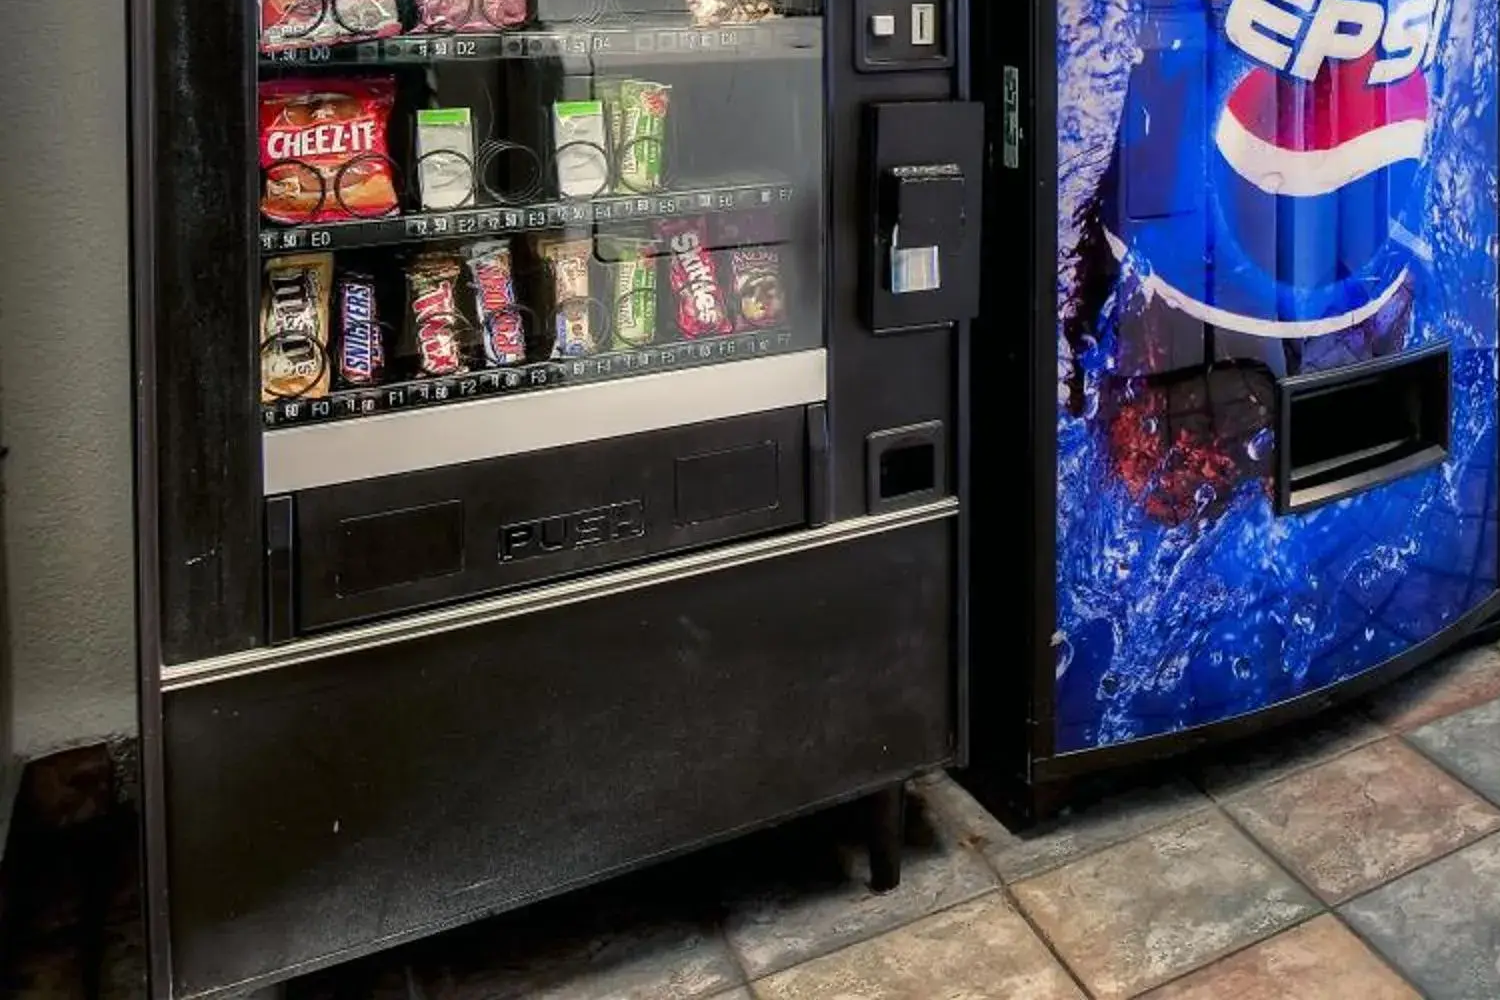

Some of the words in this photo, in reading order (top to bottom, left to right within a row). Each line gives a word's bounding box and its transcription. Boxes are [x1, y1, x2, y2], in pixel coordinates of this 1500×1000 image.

[457, 41, 476, 56] D2
[267, 120, 377, 160] CHEEZ-IT
[311, 232, 331, 247] E0
[344, 283, 372, 373] SNICKERS
[503, 505, 645, 560] PUSH
